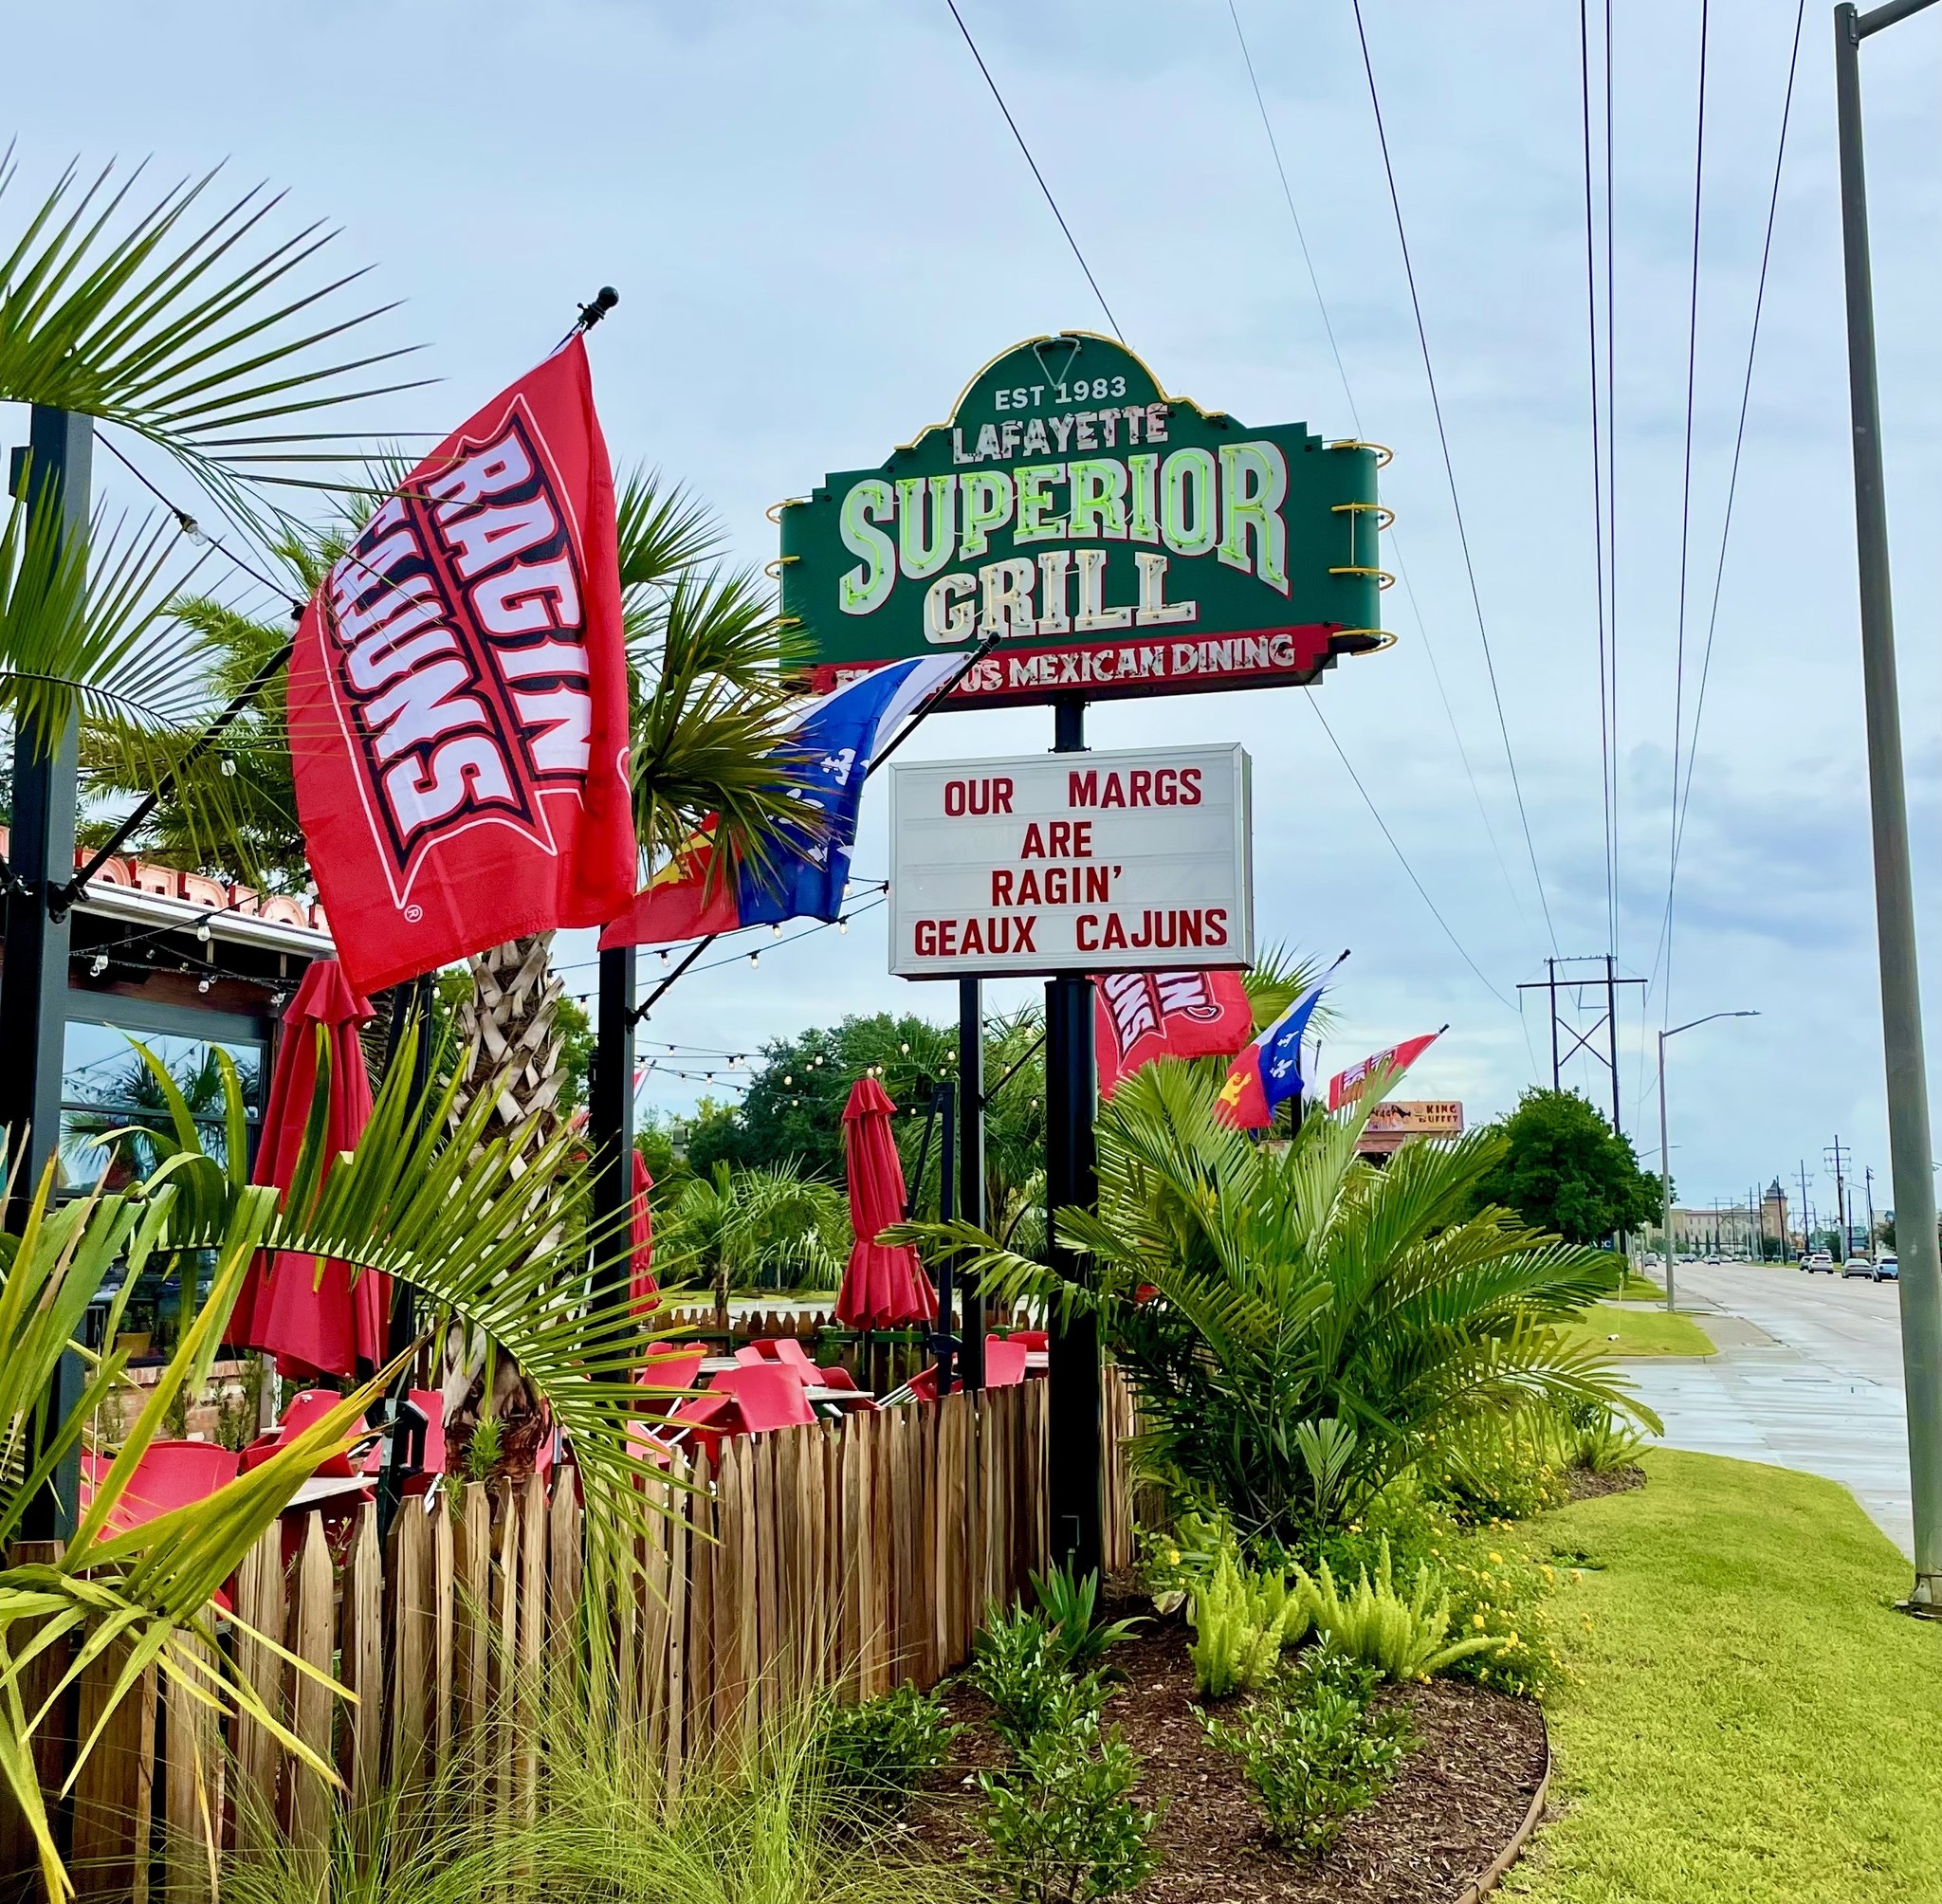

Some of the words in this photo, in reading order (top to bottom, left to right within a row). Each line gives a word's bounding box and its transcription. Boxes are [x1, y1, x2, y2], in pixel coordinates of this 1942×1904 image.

[995, 384, 1044, 411] EST
[1054, 376, 1127, 404] 1983
[952, 403, 1168, 465] LAFAYETTE
[839, 441, 1290, 615] SUPERIOR
[425, 431, 593, 771] RAGIN
[924, 549, 1197, 645] GRILL
[1009, 645, 1164, 688] MEXICAN
[1171, 634, 1295, 675] DINING
[944, 778, 1013, 816] OUR
[1069, 768, 1201, 808] MARGS
[1021, 821, 1093, 859] ARE
[992, 865, 1122, 906] RAGIN'
[915, 915, 1036, 956] GEAUX
[1076, 908, 1227, 951] CAJUNS
[1426, 1105, 1456, 1114] KING
